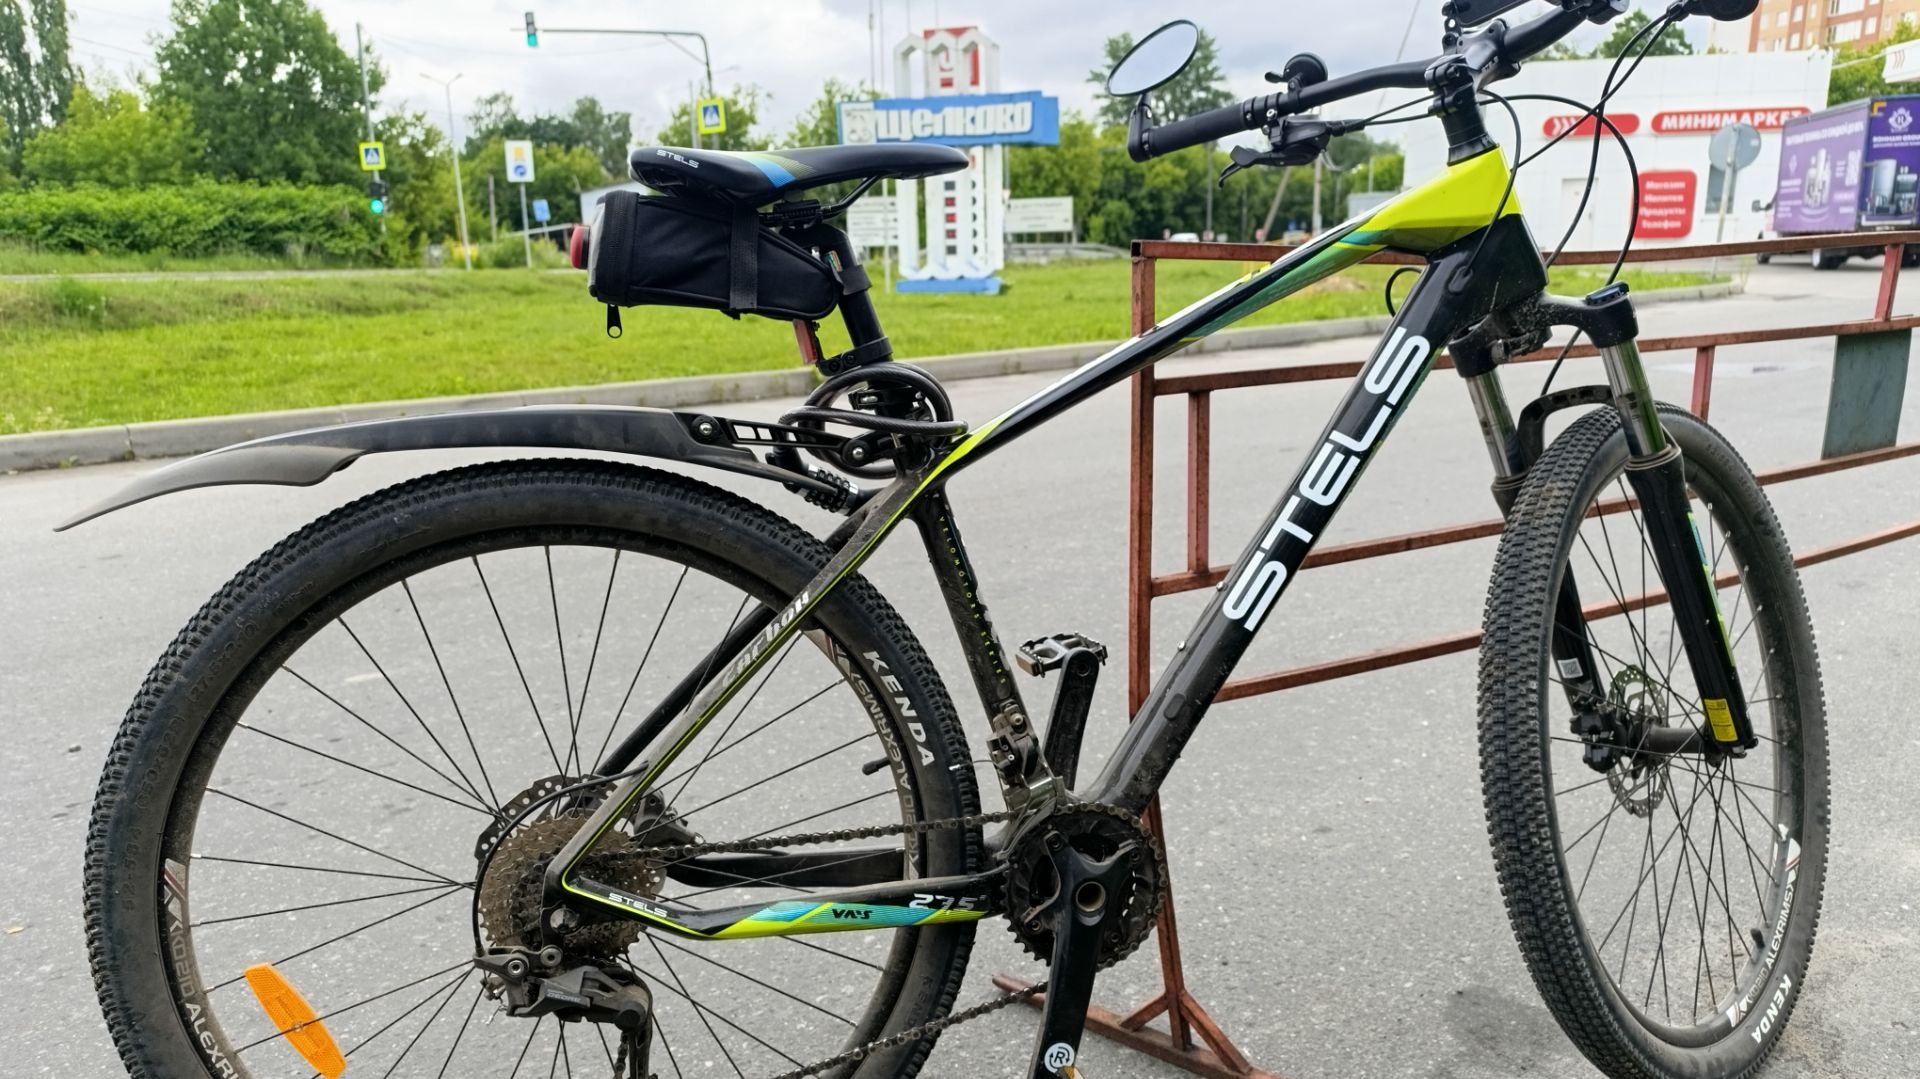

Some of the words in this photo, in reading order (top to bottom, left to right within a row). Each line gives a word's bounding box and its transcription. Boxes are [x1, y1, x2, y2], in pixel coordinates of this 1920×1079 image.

[1661, 111, 1802, 130] МИНИМАРКЕТ
[656, 149, 700, 169] STELS
[1222, 326, 1431, 632] STELS
[857, 680, 911, 791] ALEXRIMS
[863, 650, 935, 767] KENDA
[608, 893, 668, 918] STELS
[1765, 889, 1793, 969] ALEXRIMS
[1751, 974, 1792, 1044] KENDA
